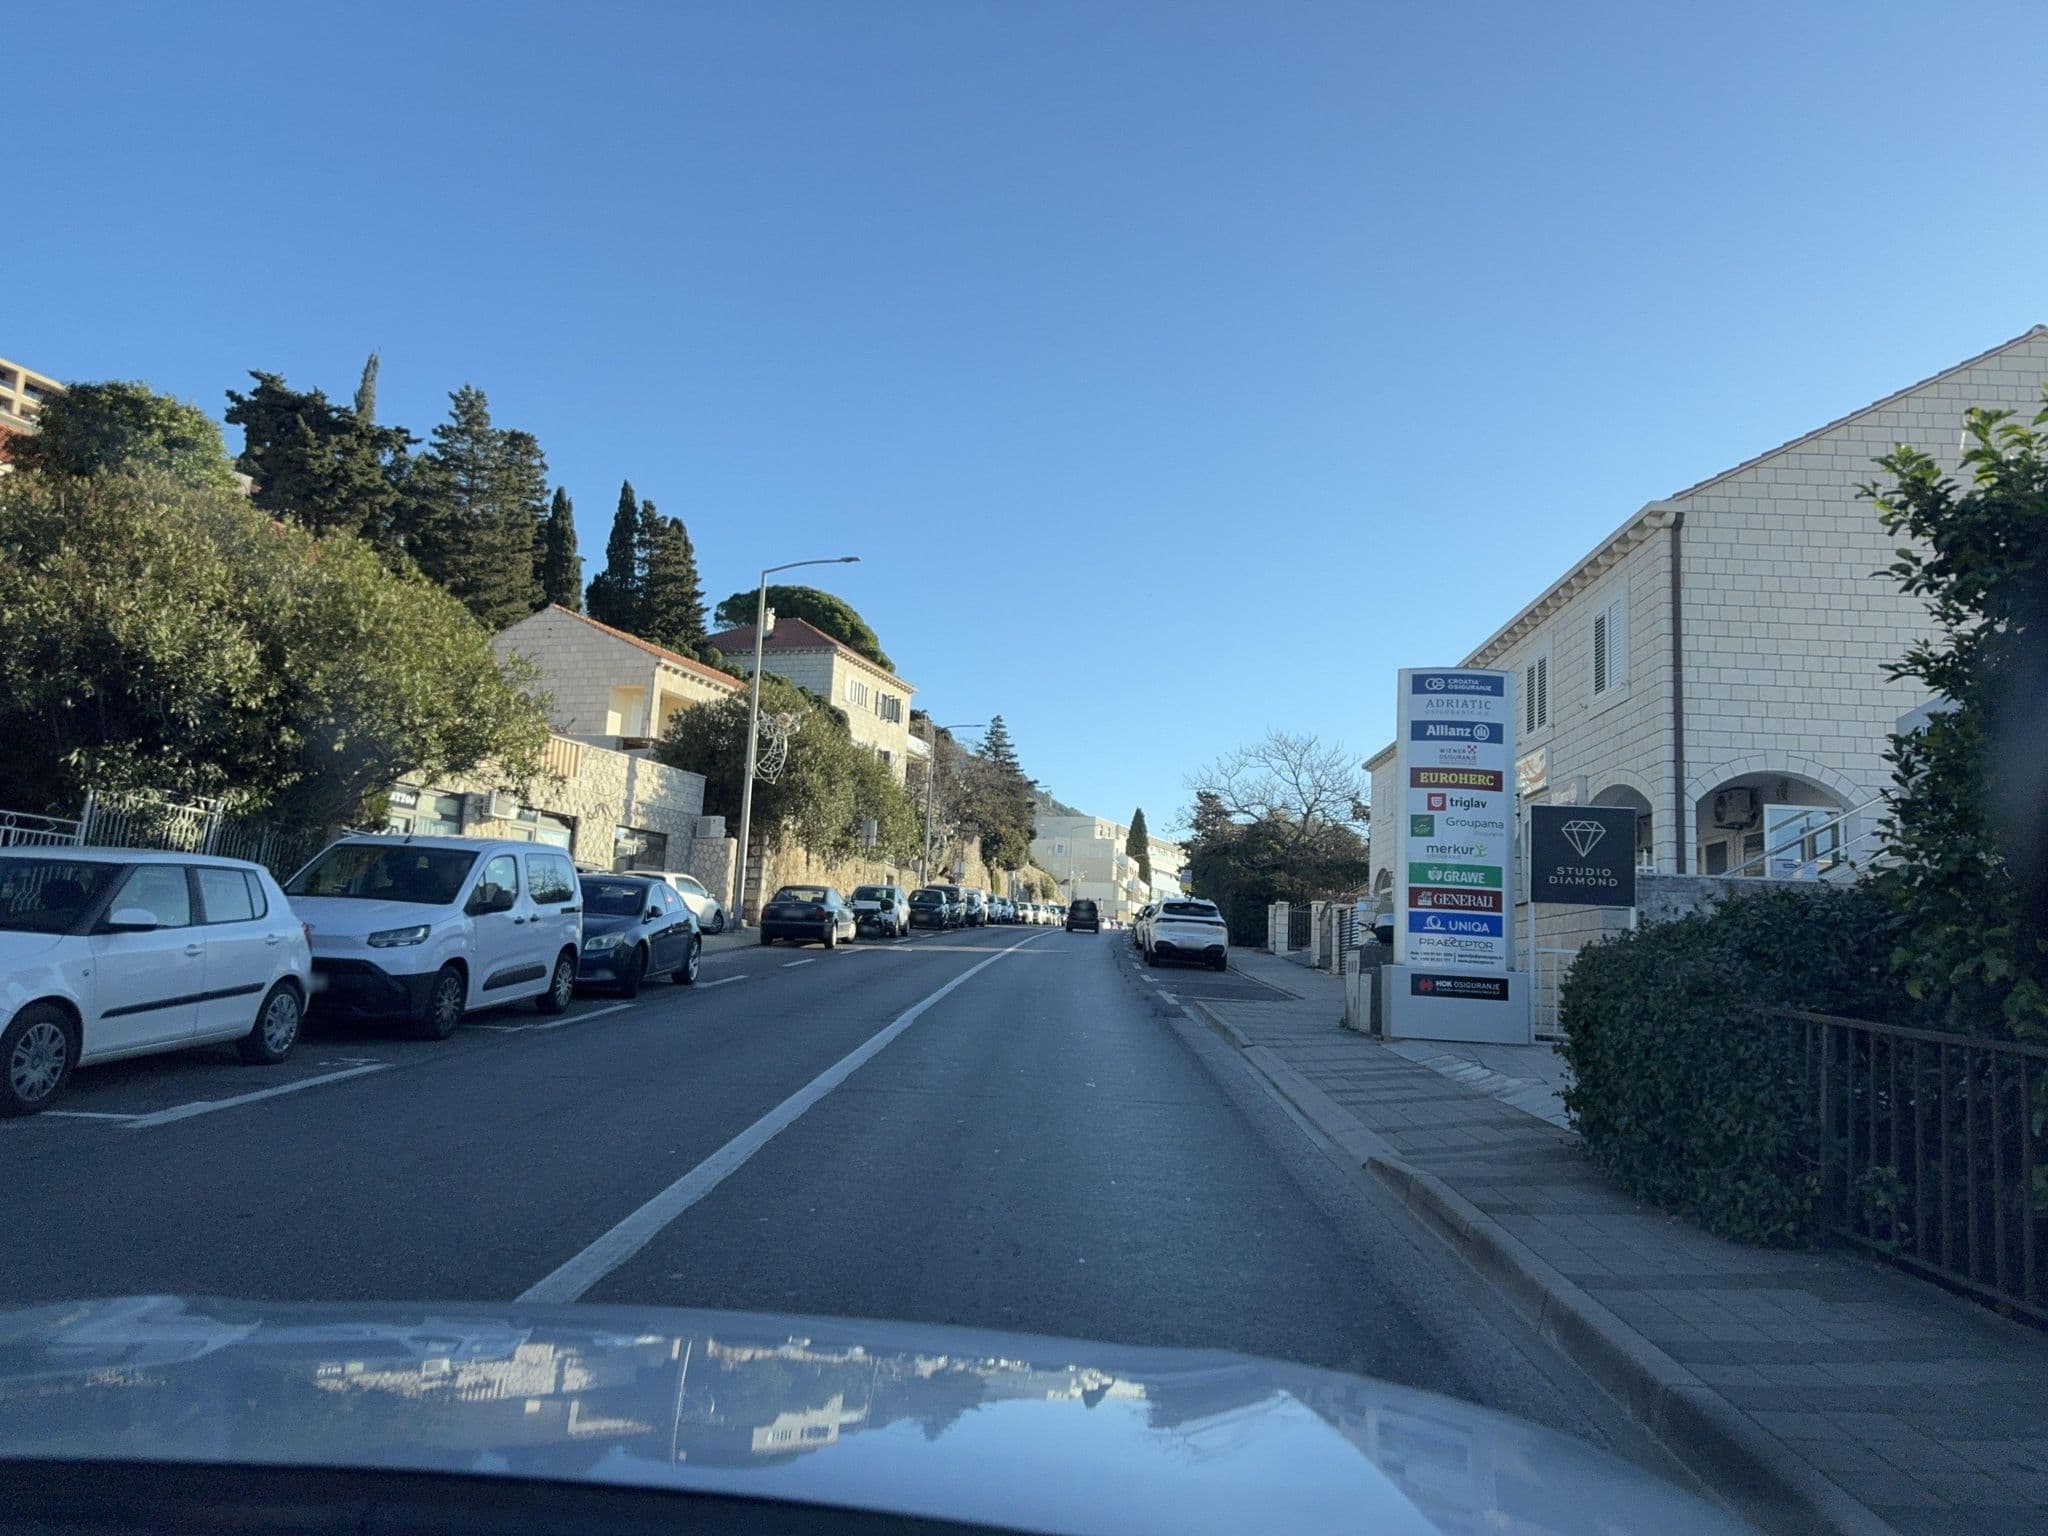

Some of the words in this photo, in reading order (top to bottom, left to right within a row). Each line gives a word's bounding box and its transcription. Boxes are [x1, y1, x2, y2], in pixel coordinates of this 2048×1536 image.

[1426, 699, 1492, 710] ADRIATIC
[1426, 724, 1472, 737] Allianz
[1420, 772, 1494, 786] EUROHERC
[1449, 797, 1487, 811] triglav
[1446, 817, 1504, 829] Groupama
[1426, 844, 1475, 855] merkur
[1443, 870, 1485, 884] GRAWE
[1556, 866, 1612, 877] STUDIO
[1549, 875, 1618, 887] DIAMOND
[1433, 893, 1494, 908] GENERALI
[1448, 920, 1490, 933] UNIQA
[1419, 937, 1494, 950] PRAECEPTOR
[1435, 980, 1453, 988] HOK
[1453, 981, 1501, 991] OSIGURANJE
